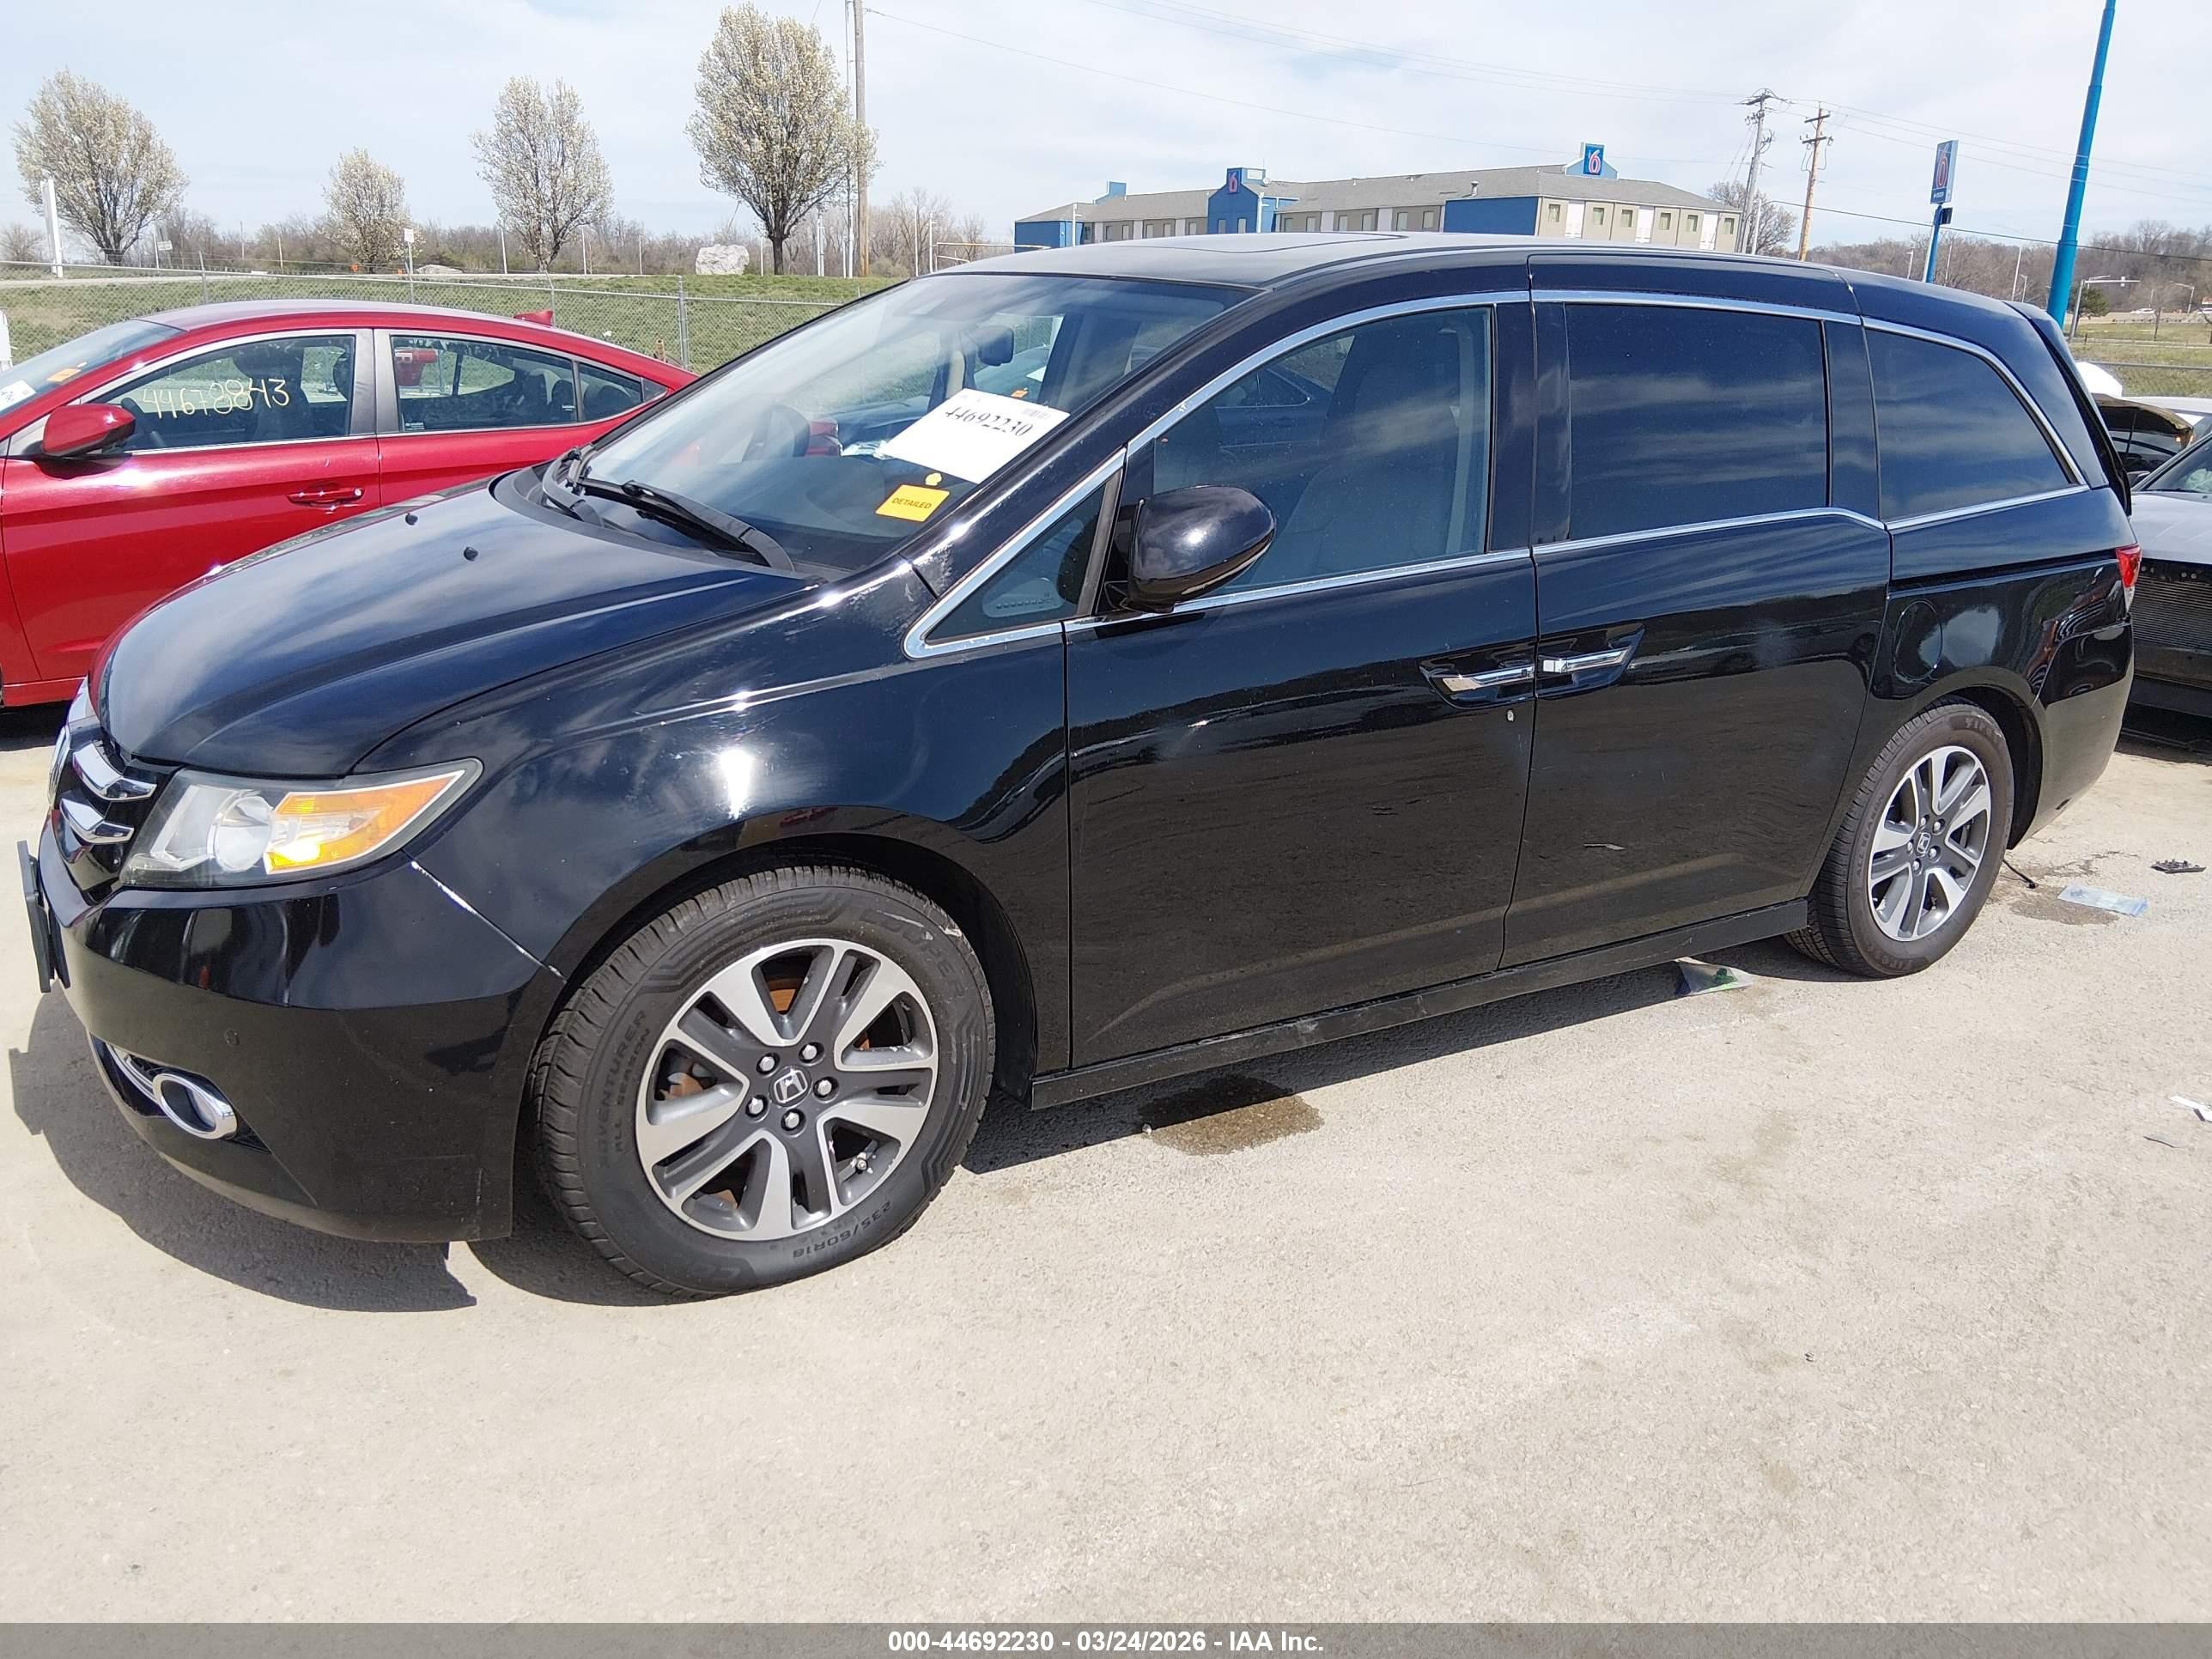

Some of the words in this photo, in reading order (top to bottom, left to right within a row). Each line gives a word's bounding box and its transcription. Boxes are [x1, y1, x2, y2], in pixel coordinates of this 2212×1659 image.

[1589, 149, 1601, 173] 6
[1936, 143, 1948, 188] 6
[143, 377, 289, 419] 44678843
[945, 406, 1034, 437] 44692230
[891, 497, 933, 509] DETAILED
[793, 1201, 893, 1258] 235/60R18
